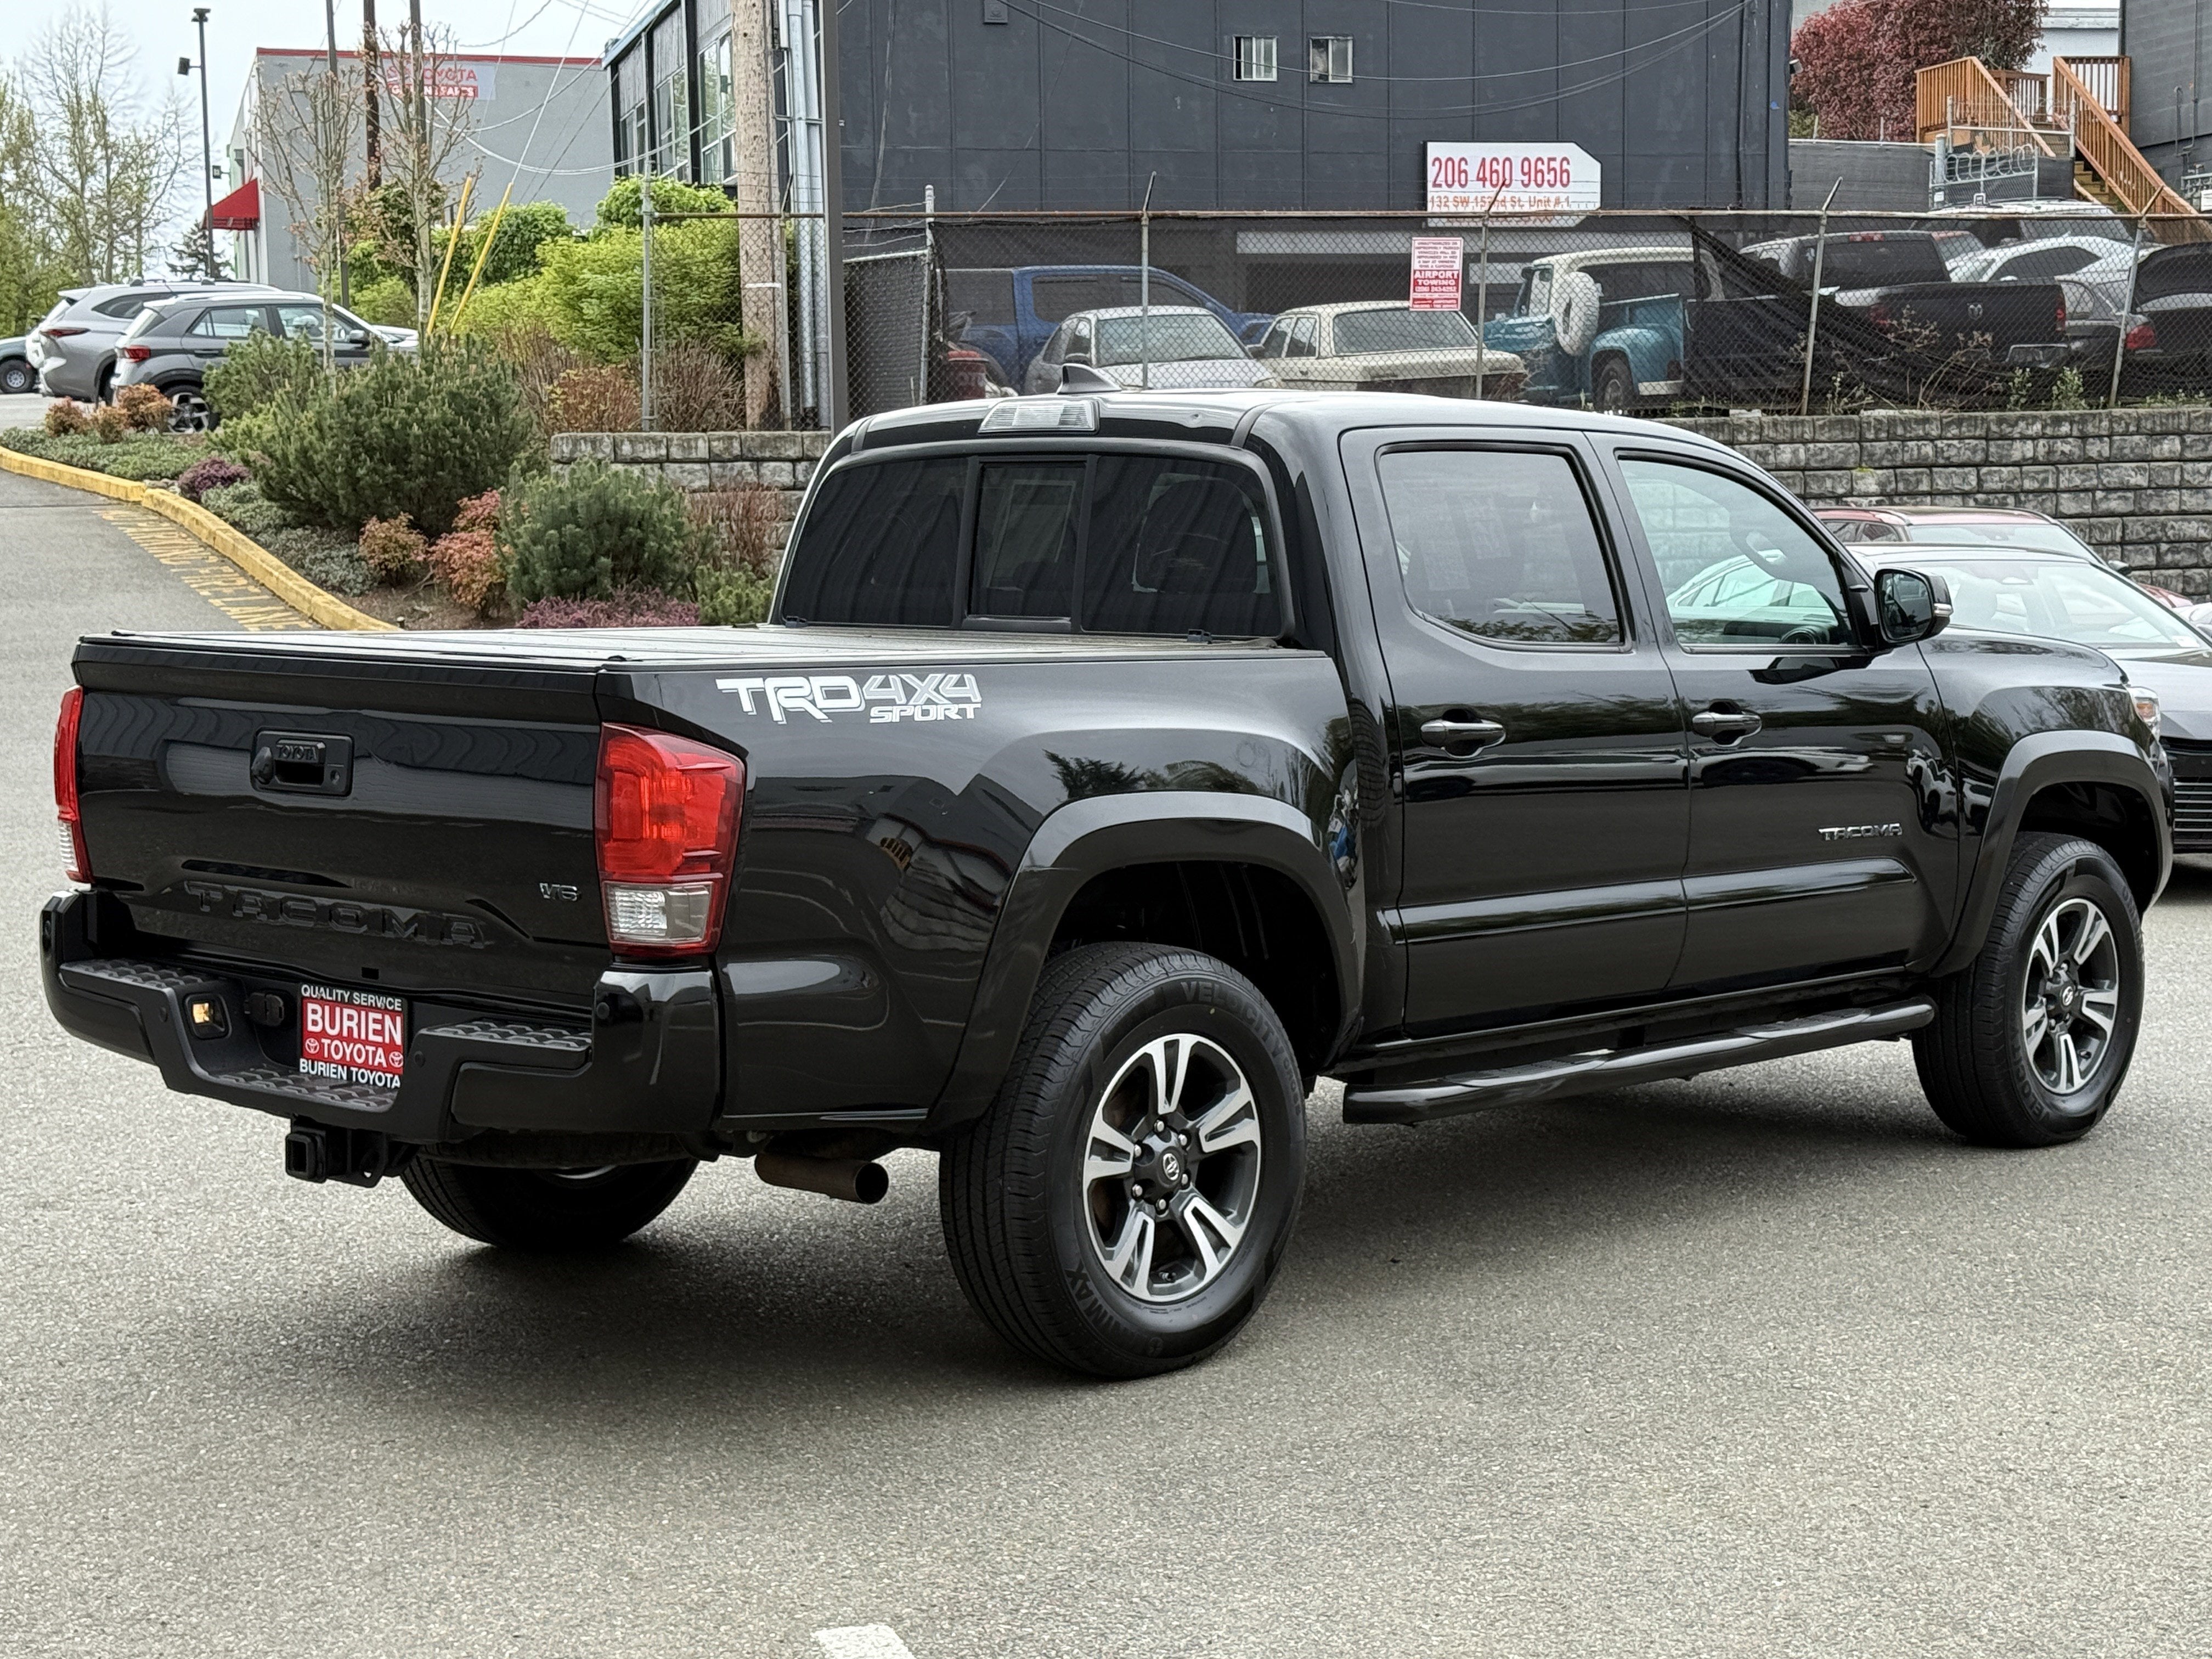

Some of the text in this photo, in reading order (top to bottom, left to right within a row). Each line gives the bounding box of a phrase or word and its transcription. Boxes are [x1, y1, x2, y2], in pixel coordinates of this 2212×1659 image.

[1432, 156, 1571, 188] 206 460 9656
[1430, 195, 1449, 207] 132
[1453, 195, 1470, 207] SW
[1528, 195, 1551, 207] Unit
[1414, 270, 1459, 279] AIRPORT
[715, 675, 866, 724] TRD
[870, 703, 982, 724] SPORT
[1818, 822, 1903, 842] TACOMA
[539, 882, 578, 901] V6
[184, 880, 486, 950] TACOMA
[301, 984, 402, 1011] QUALITY SERVICE
[307, 1002, 402, 1046] BURIEN
[321, 1037, 387, 1068] TOYOTA
[300, 1058, 401, 1089] BURIEN TOYOTA
